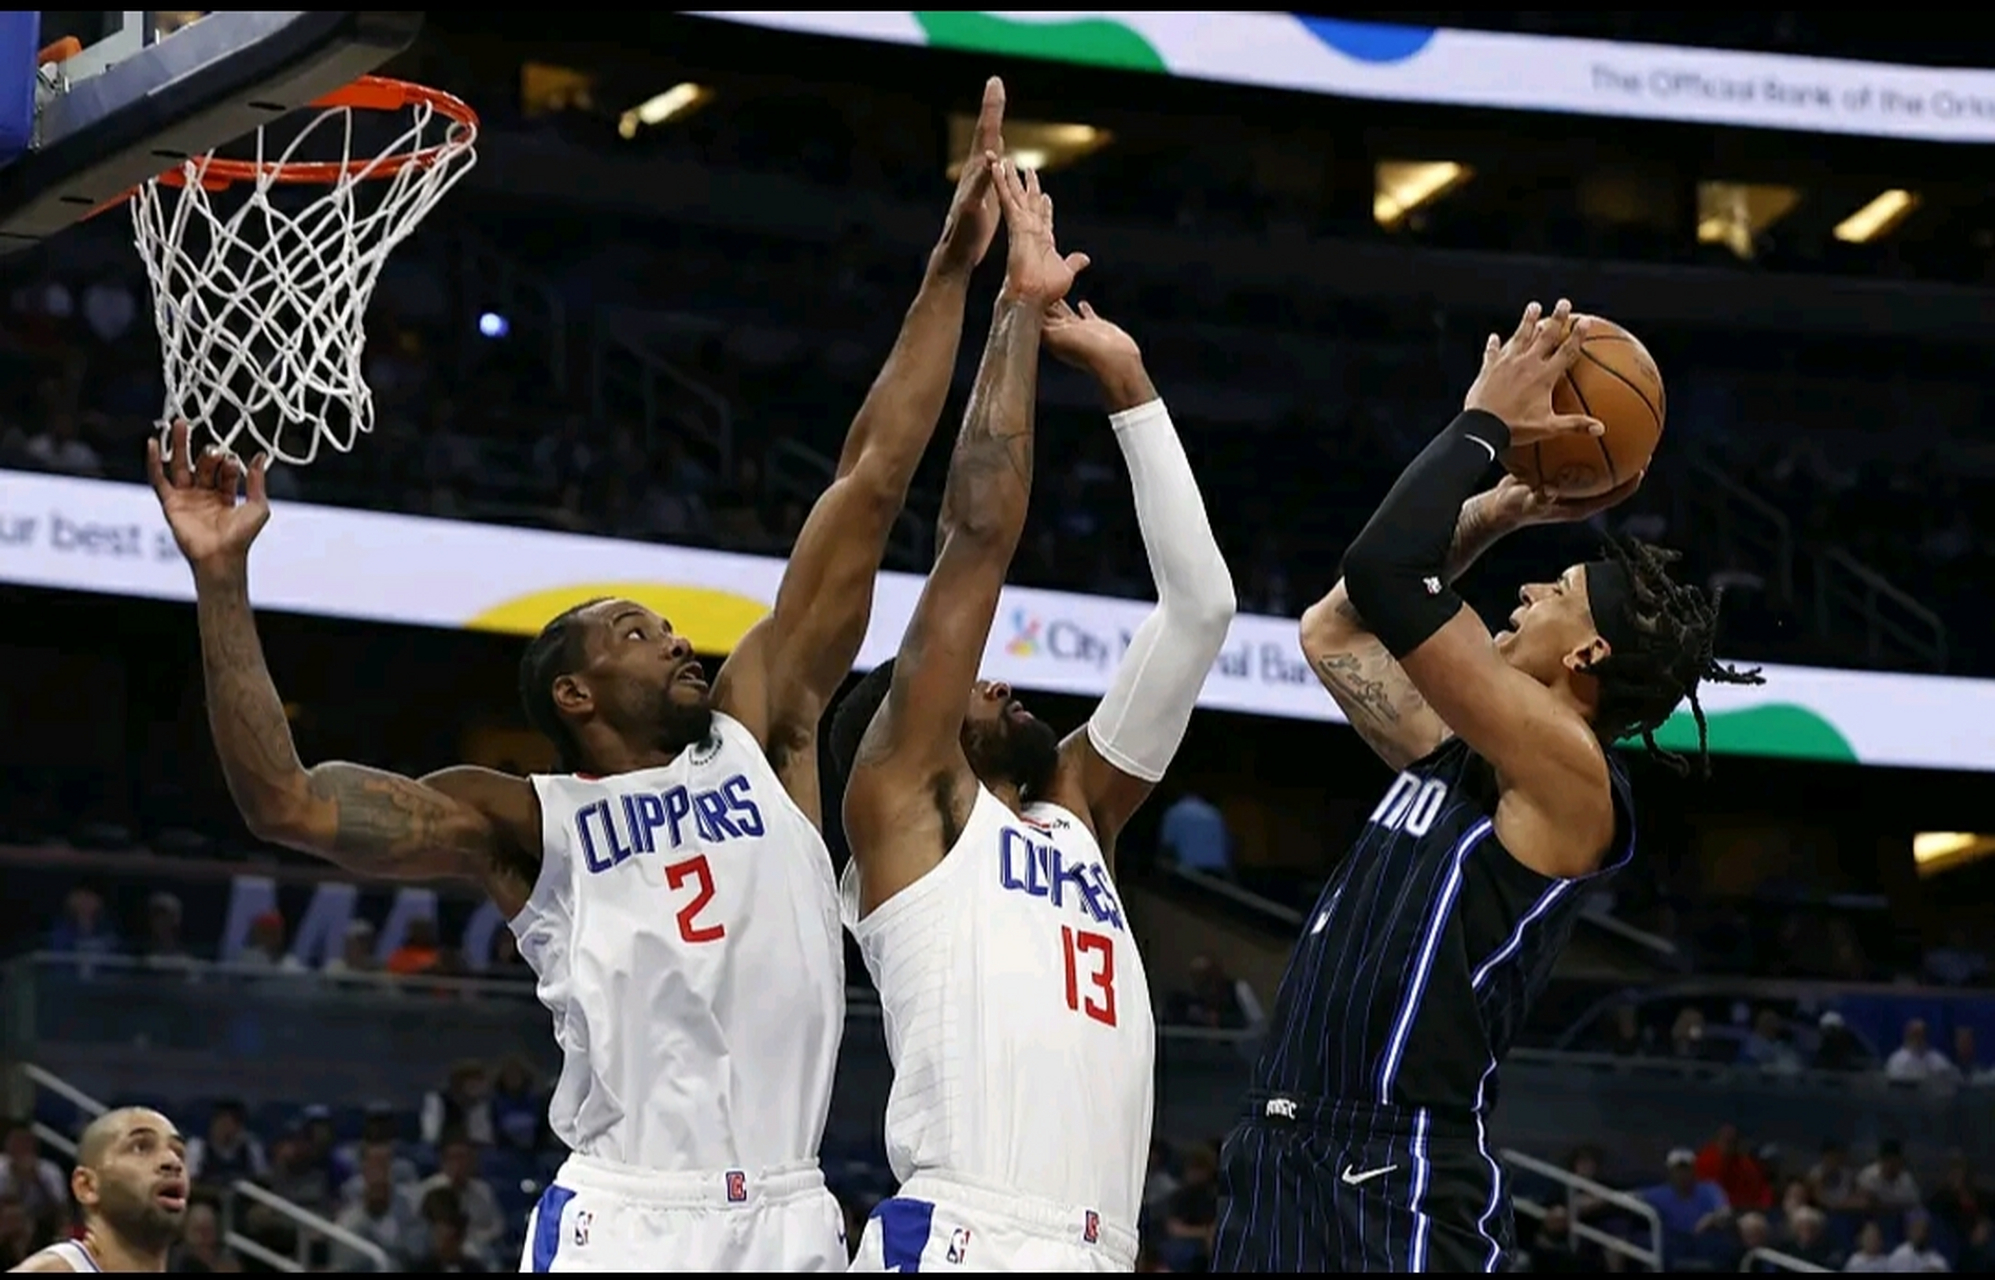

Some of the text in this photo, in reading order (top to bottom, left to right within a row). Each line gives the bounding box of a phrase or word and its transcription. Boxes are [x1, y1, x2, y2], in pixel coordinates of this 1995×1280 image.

[1590, 64, 1641, 93] The
[1650, 69, 1754, 101] Official
[1762, 74, 1831, 106] Bank
[1842, 84, 1873, 110] of
[1880, 87, 1924, 115] the
[51, 509, 143, 558] best
[1048, 620, 1108, 671] City
[1260, 642, 1310, 685] Ban
[664, 854, 725, 943] 2
[1061, 924, 1117, 1028] 13
